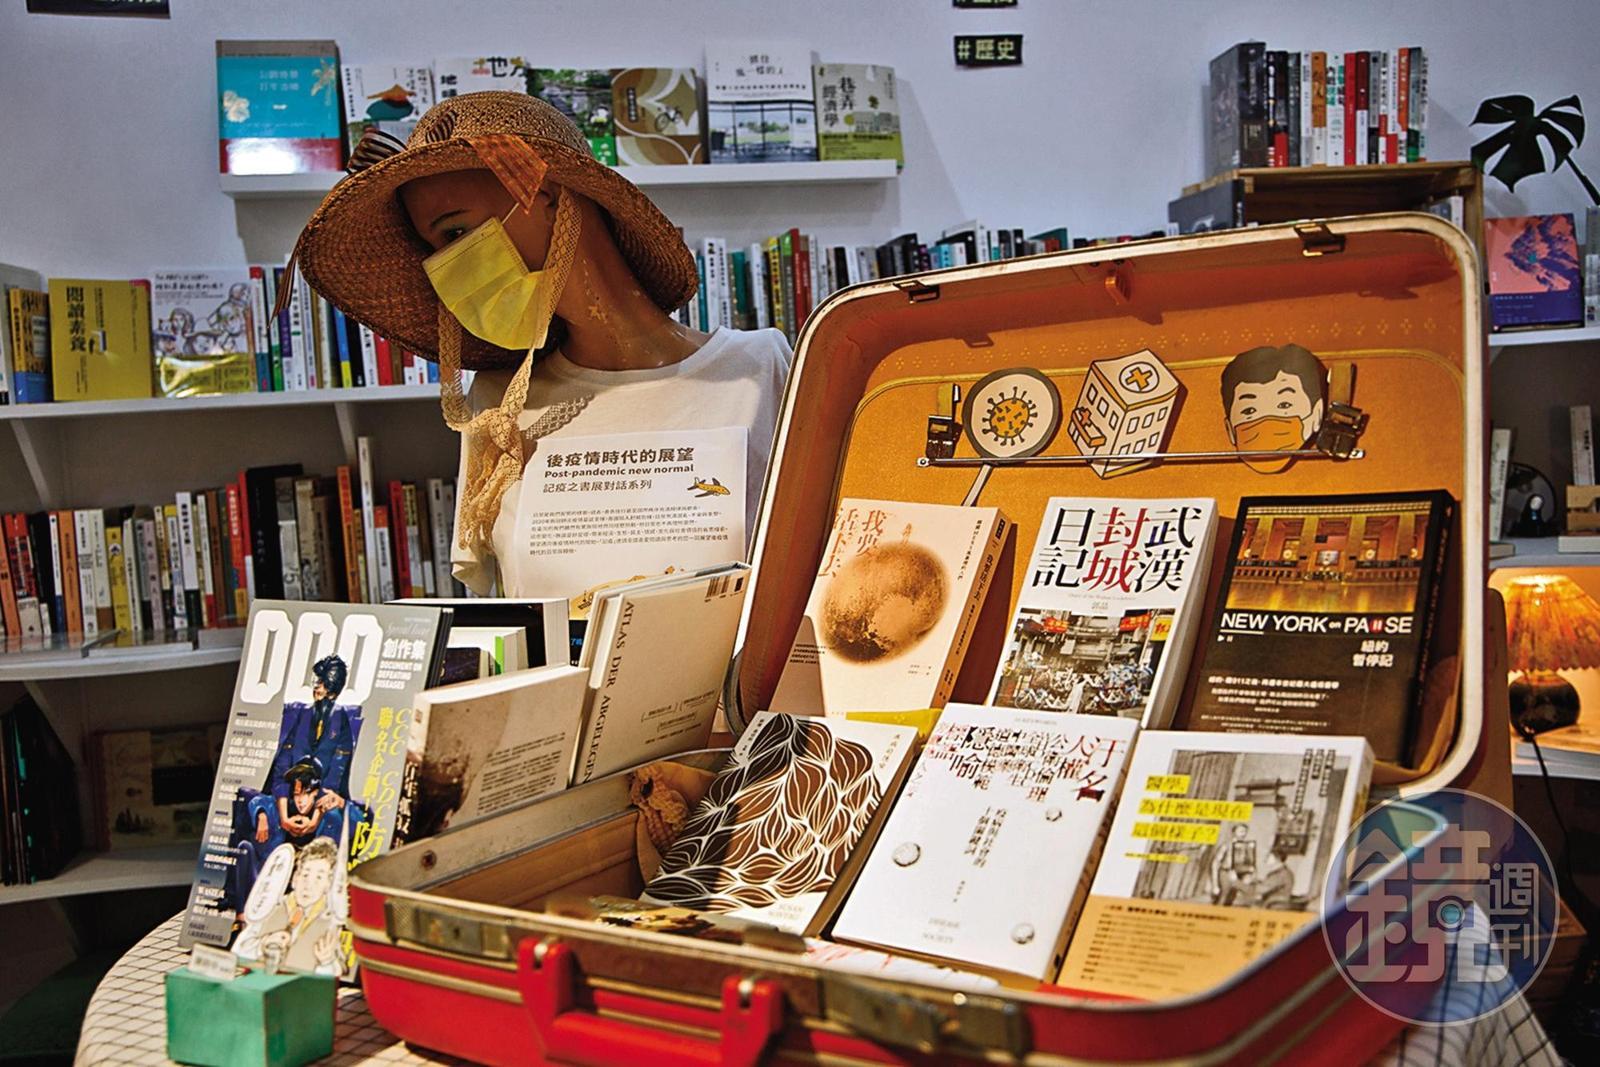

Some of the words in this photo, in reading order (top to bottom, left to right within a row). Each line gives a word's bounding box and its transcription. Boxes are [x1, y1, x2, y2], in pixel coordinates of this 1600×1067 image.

[546, 447, 695, 468] 後疫情時代的展望
[544, 466, 626, 479] Post-pandemic
[628, 467, 652, 476] new
[654, 464, 694, 475] normal
[543, 479, 652, 494] 記疫之書展對話系列
[1032, 507, 1095, 588] 日記
[1082, 507, 1150, 593] 封城
[1134, 507, 1202, 593] 武漢
[616, 601, 635, 649] ATLAS
[1220, 613, 1268, 630] NEW
[1272, 614, 1328, 632] YORK
[1329, 621, 1342, 629] on
[382, 638, 427, 660] 創作集
[1360, 639, 1389, 653] 紐約
[379, 660, 413, 671] DOCUMENT
[1352, 653, 1394, 668] 暫停記
[377, 670, 412, 681] DEFEATING
[606, 656, 622, 688] DER
[375, 679, 406, 690] DISEASES
[389, 707, 411, 756] CCC
[375, 771, 399, 820] CDC
[1139, 799, 1245, 819] 為什麼是現在
